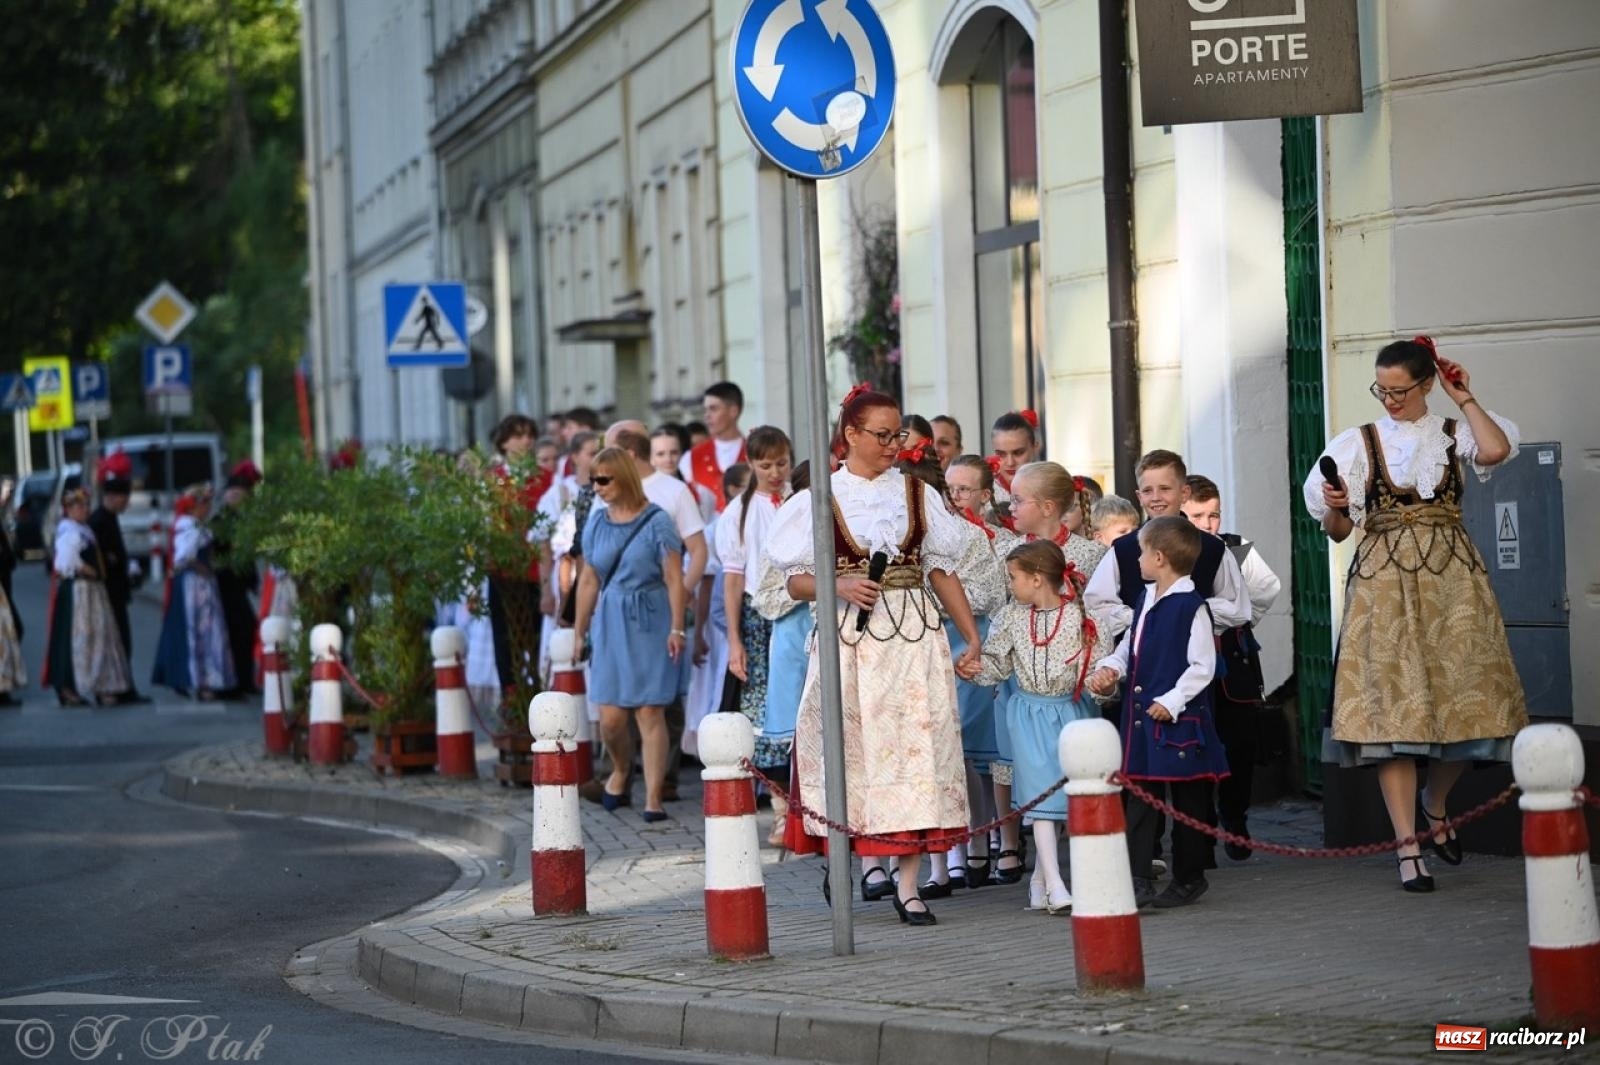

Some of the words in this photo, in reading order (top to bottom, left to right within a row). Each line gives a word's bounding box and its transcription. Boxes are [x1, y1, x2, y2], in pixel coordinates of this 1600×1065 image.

[1191, 33, 1309, 66] PORTE
[1193, 67, 1309, 87] APARTAMENTY
[154, 348, 182, 388] P
